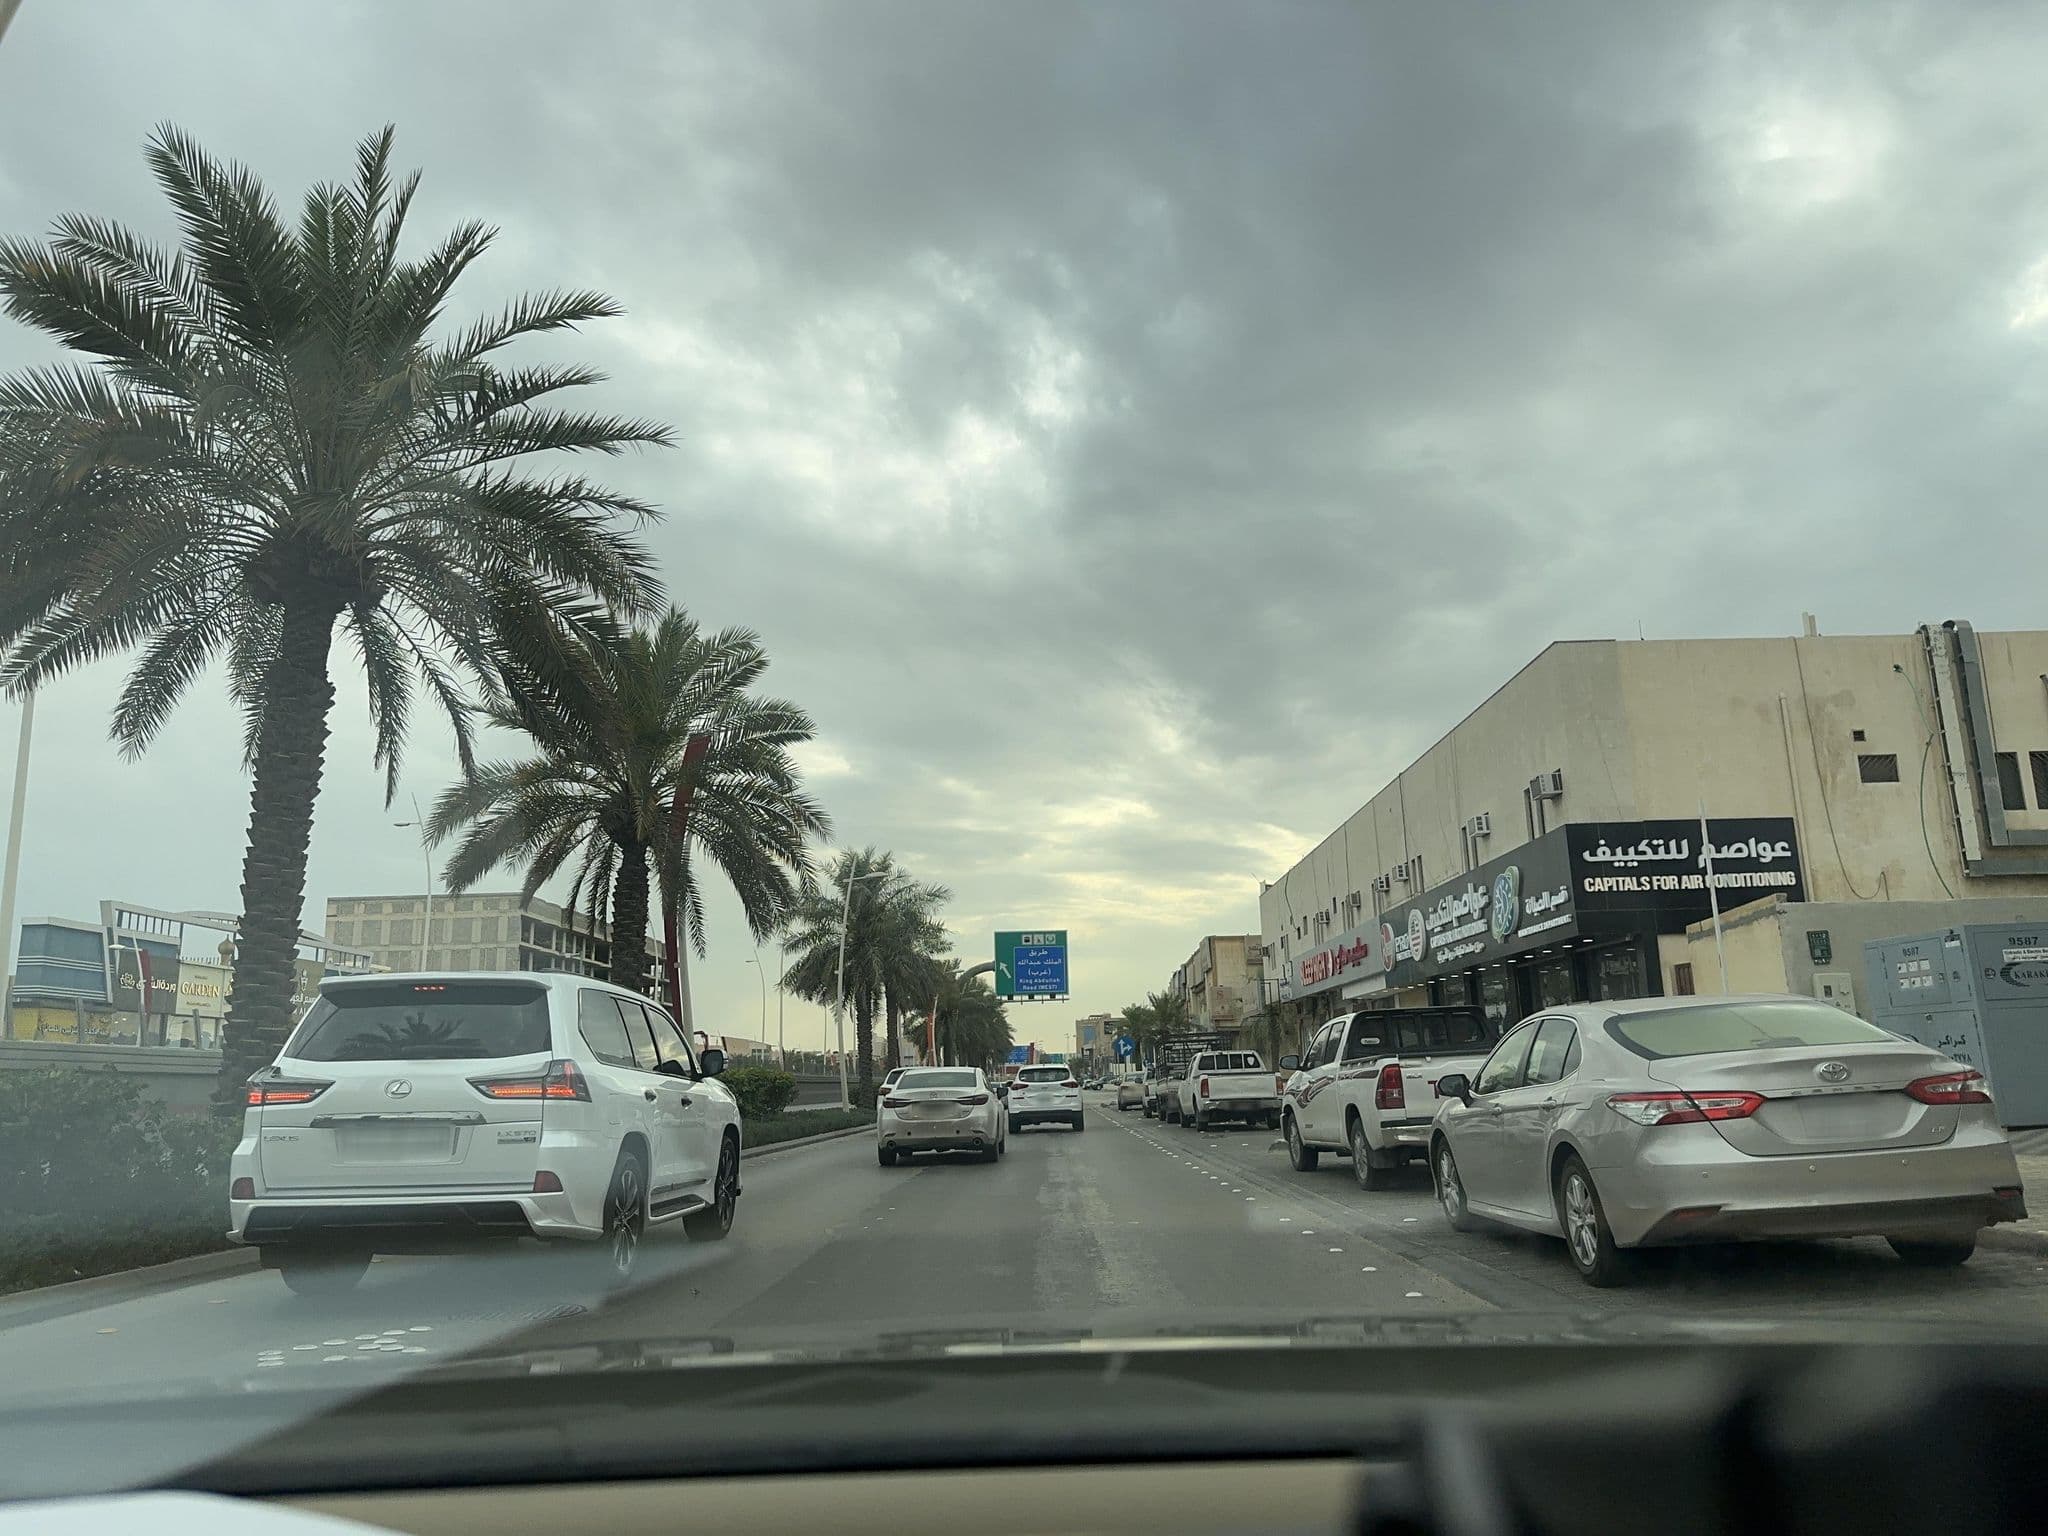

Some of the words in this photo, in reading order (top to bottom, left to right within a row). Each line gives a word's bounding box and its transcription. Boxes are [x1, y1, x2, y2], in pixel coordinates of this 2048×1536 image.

[1582, 838, 1690, 868] للتكييف
[1698, 838, 1792, 869] عواصم
[1584, 875, 1651, 893] CAPITALS
[1652, 875, 1679, 891] FOR
[1681, 874, 1704, 890] AIR
[2008, 936, 2039, 946] 9587
[2014, 969, 2048, 980] KARAK
[181, 981, 220, 998] GARDEN
